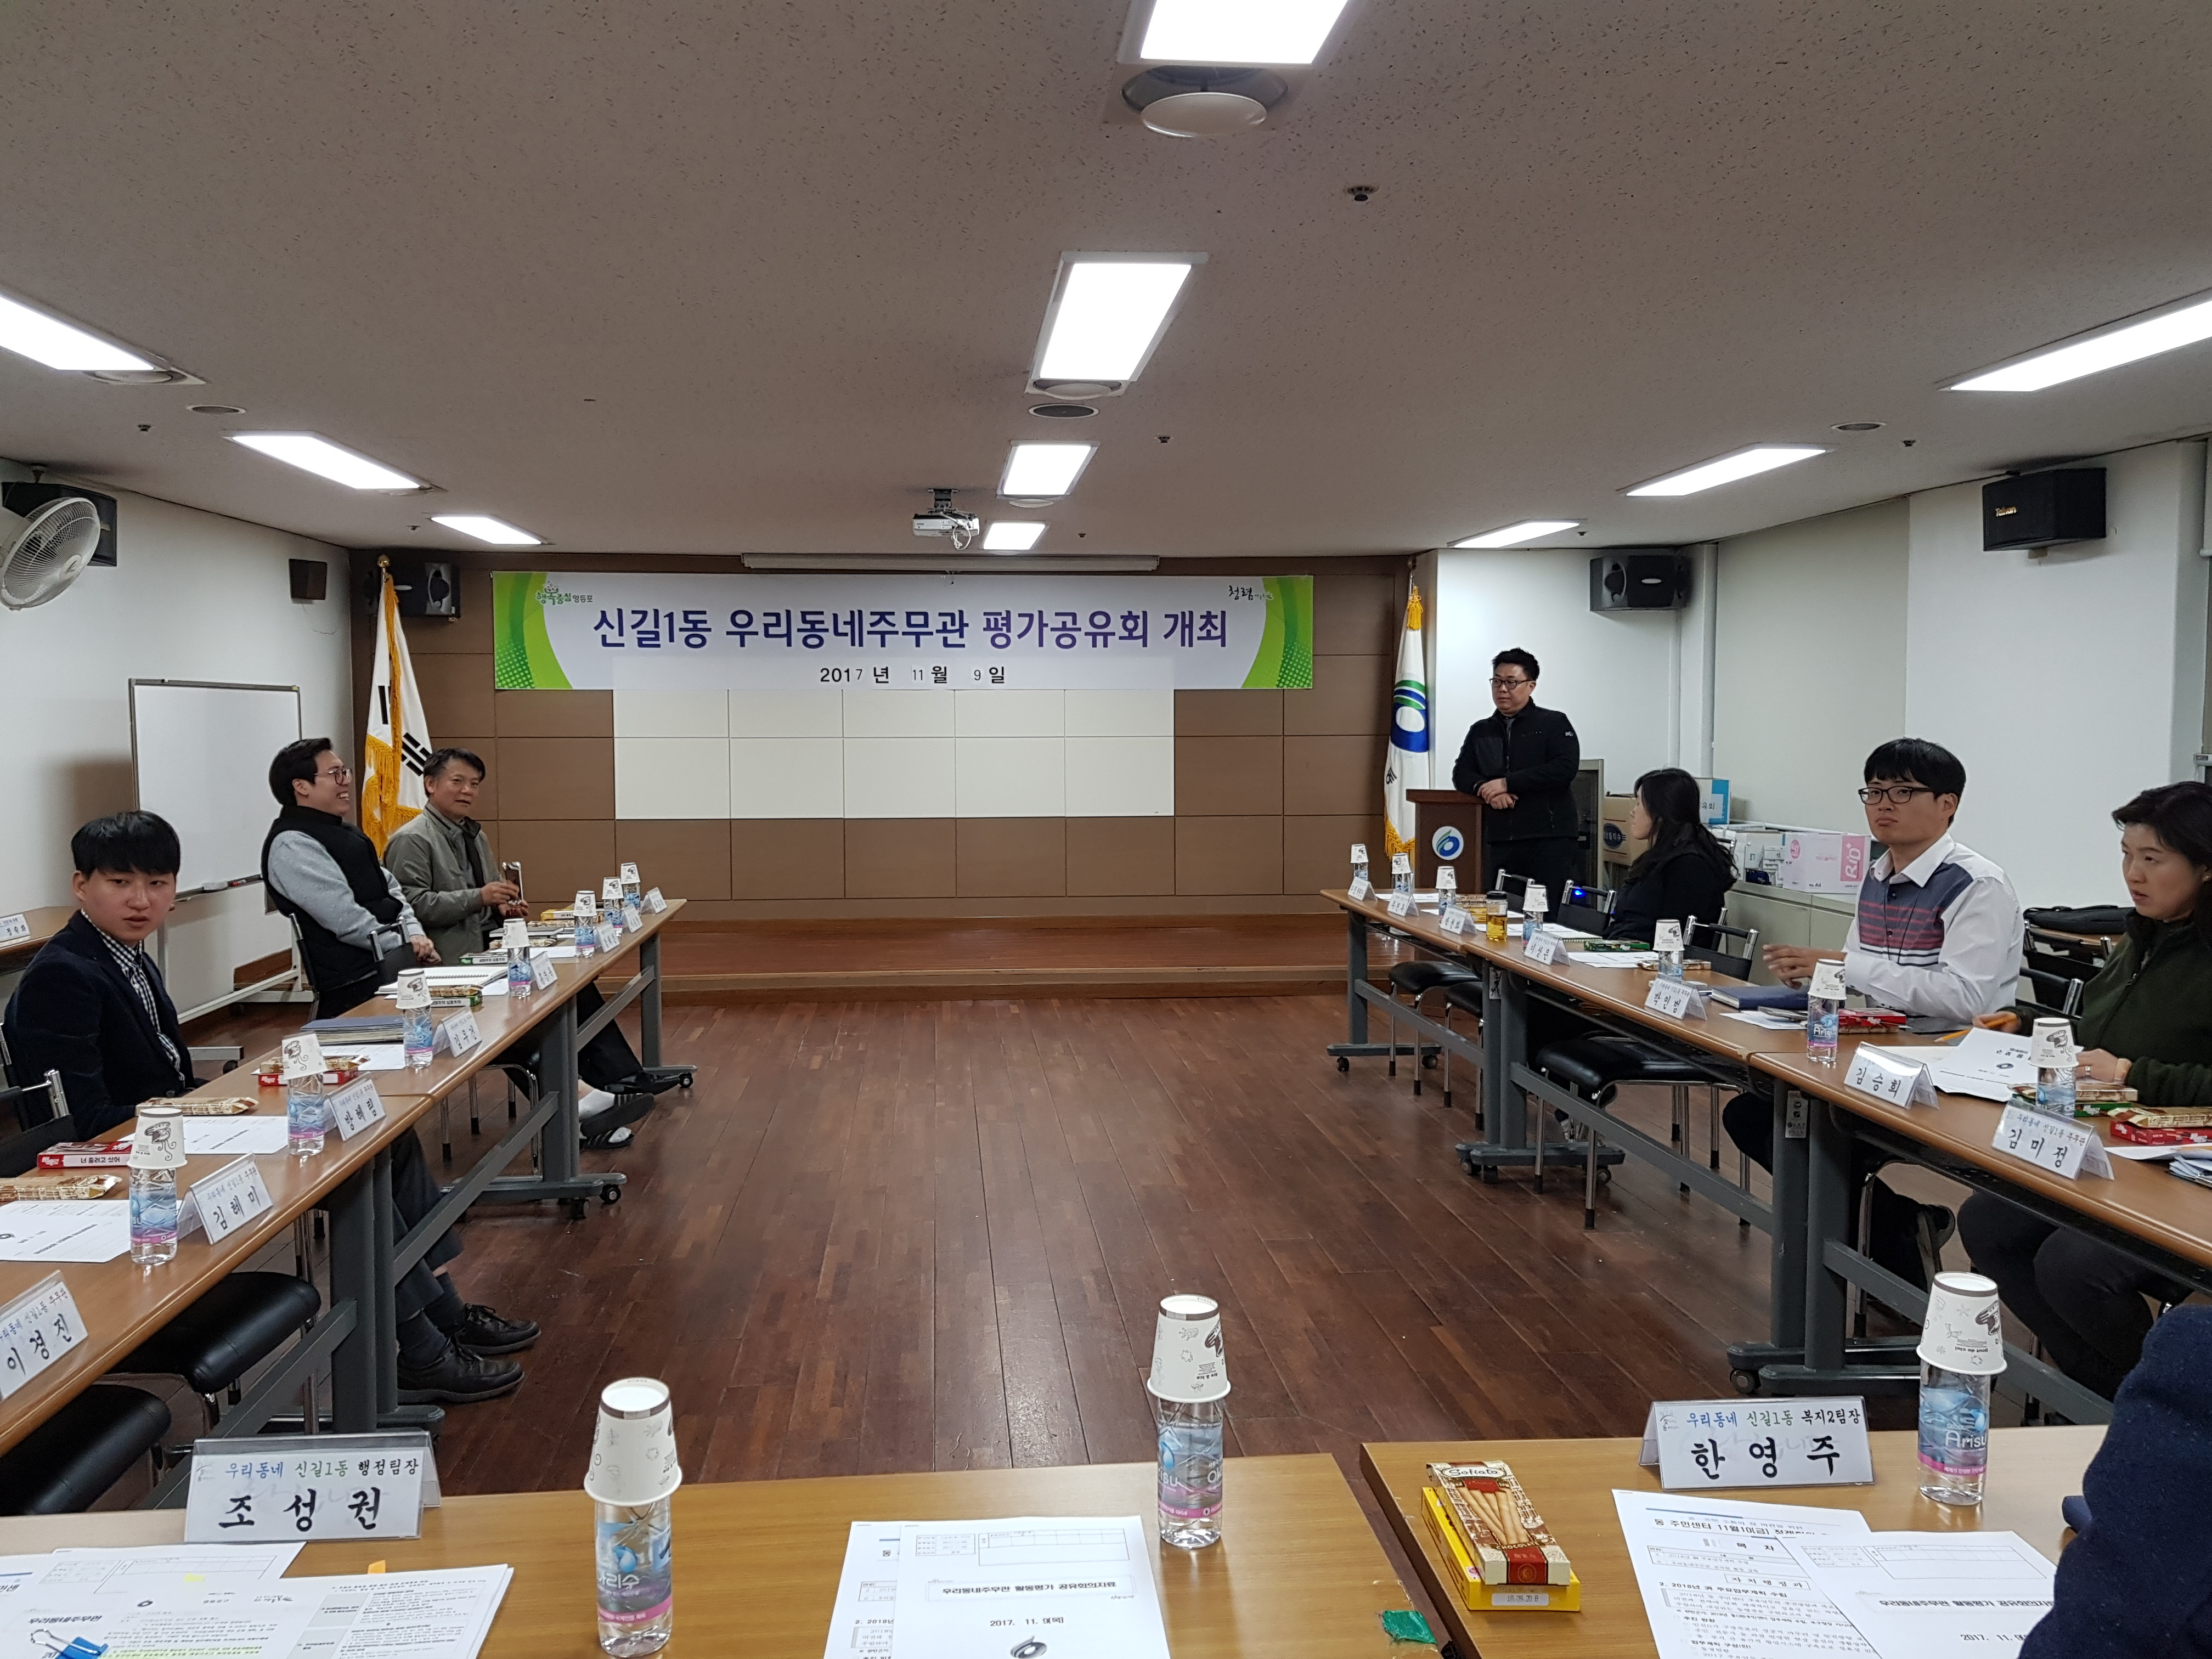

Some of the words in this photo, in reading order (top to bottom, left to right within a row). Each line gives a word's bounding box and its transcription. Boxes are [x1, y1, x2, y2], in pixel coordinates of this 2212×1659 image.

[572, 595, 593, 603] 영등포
[594, 608, 712, 649] 신길1동
[726, 609, 969, 650] 우리동네주무관
[983, 610, 1148, 650] 평가공유회
[1163, 610, 1227, 648] 개최
[820, 667, 863, 683] 2017
[873, 667, 890, 684] 년
[912, 669, 924, 682] 11
[931, 666, 948, 684] 월
[974, 669, 981, 682] 9
[989, 666, 1006, 684] 일
[1686, 1411, 1738, 1428] 우리동네
[1746, 1410, 1793, 1427] 신길1동
[1801, 1408, 1860, 1425] 복지2팀장
[1945, 1430, 1987, 1449] Arisu
[224, 1461, 284, 1480] 우리동네
[294, 1459, 348, 1479] 신길1동
[358, 1457, 419, 1477] 행정팀장
[1671, 1520, 1712, 1530] 주민센터
[943, 1585, 1010, 1594] 우리동네주무관
[1015, 1584, 1054, 1592] 활동평가
[1058, 1581, 1117, 1590] 공유회의자료
